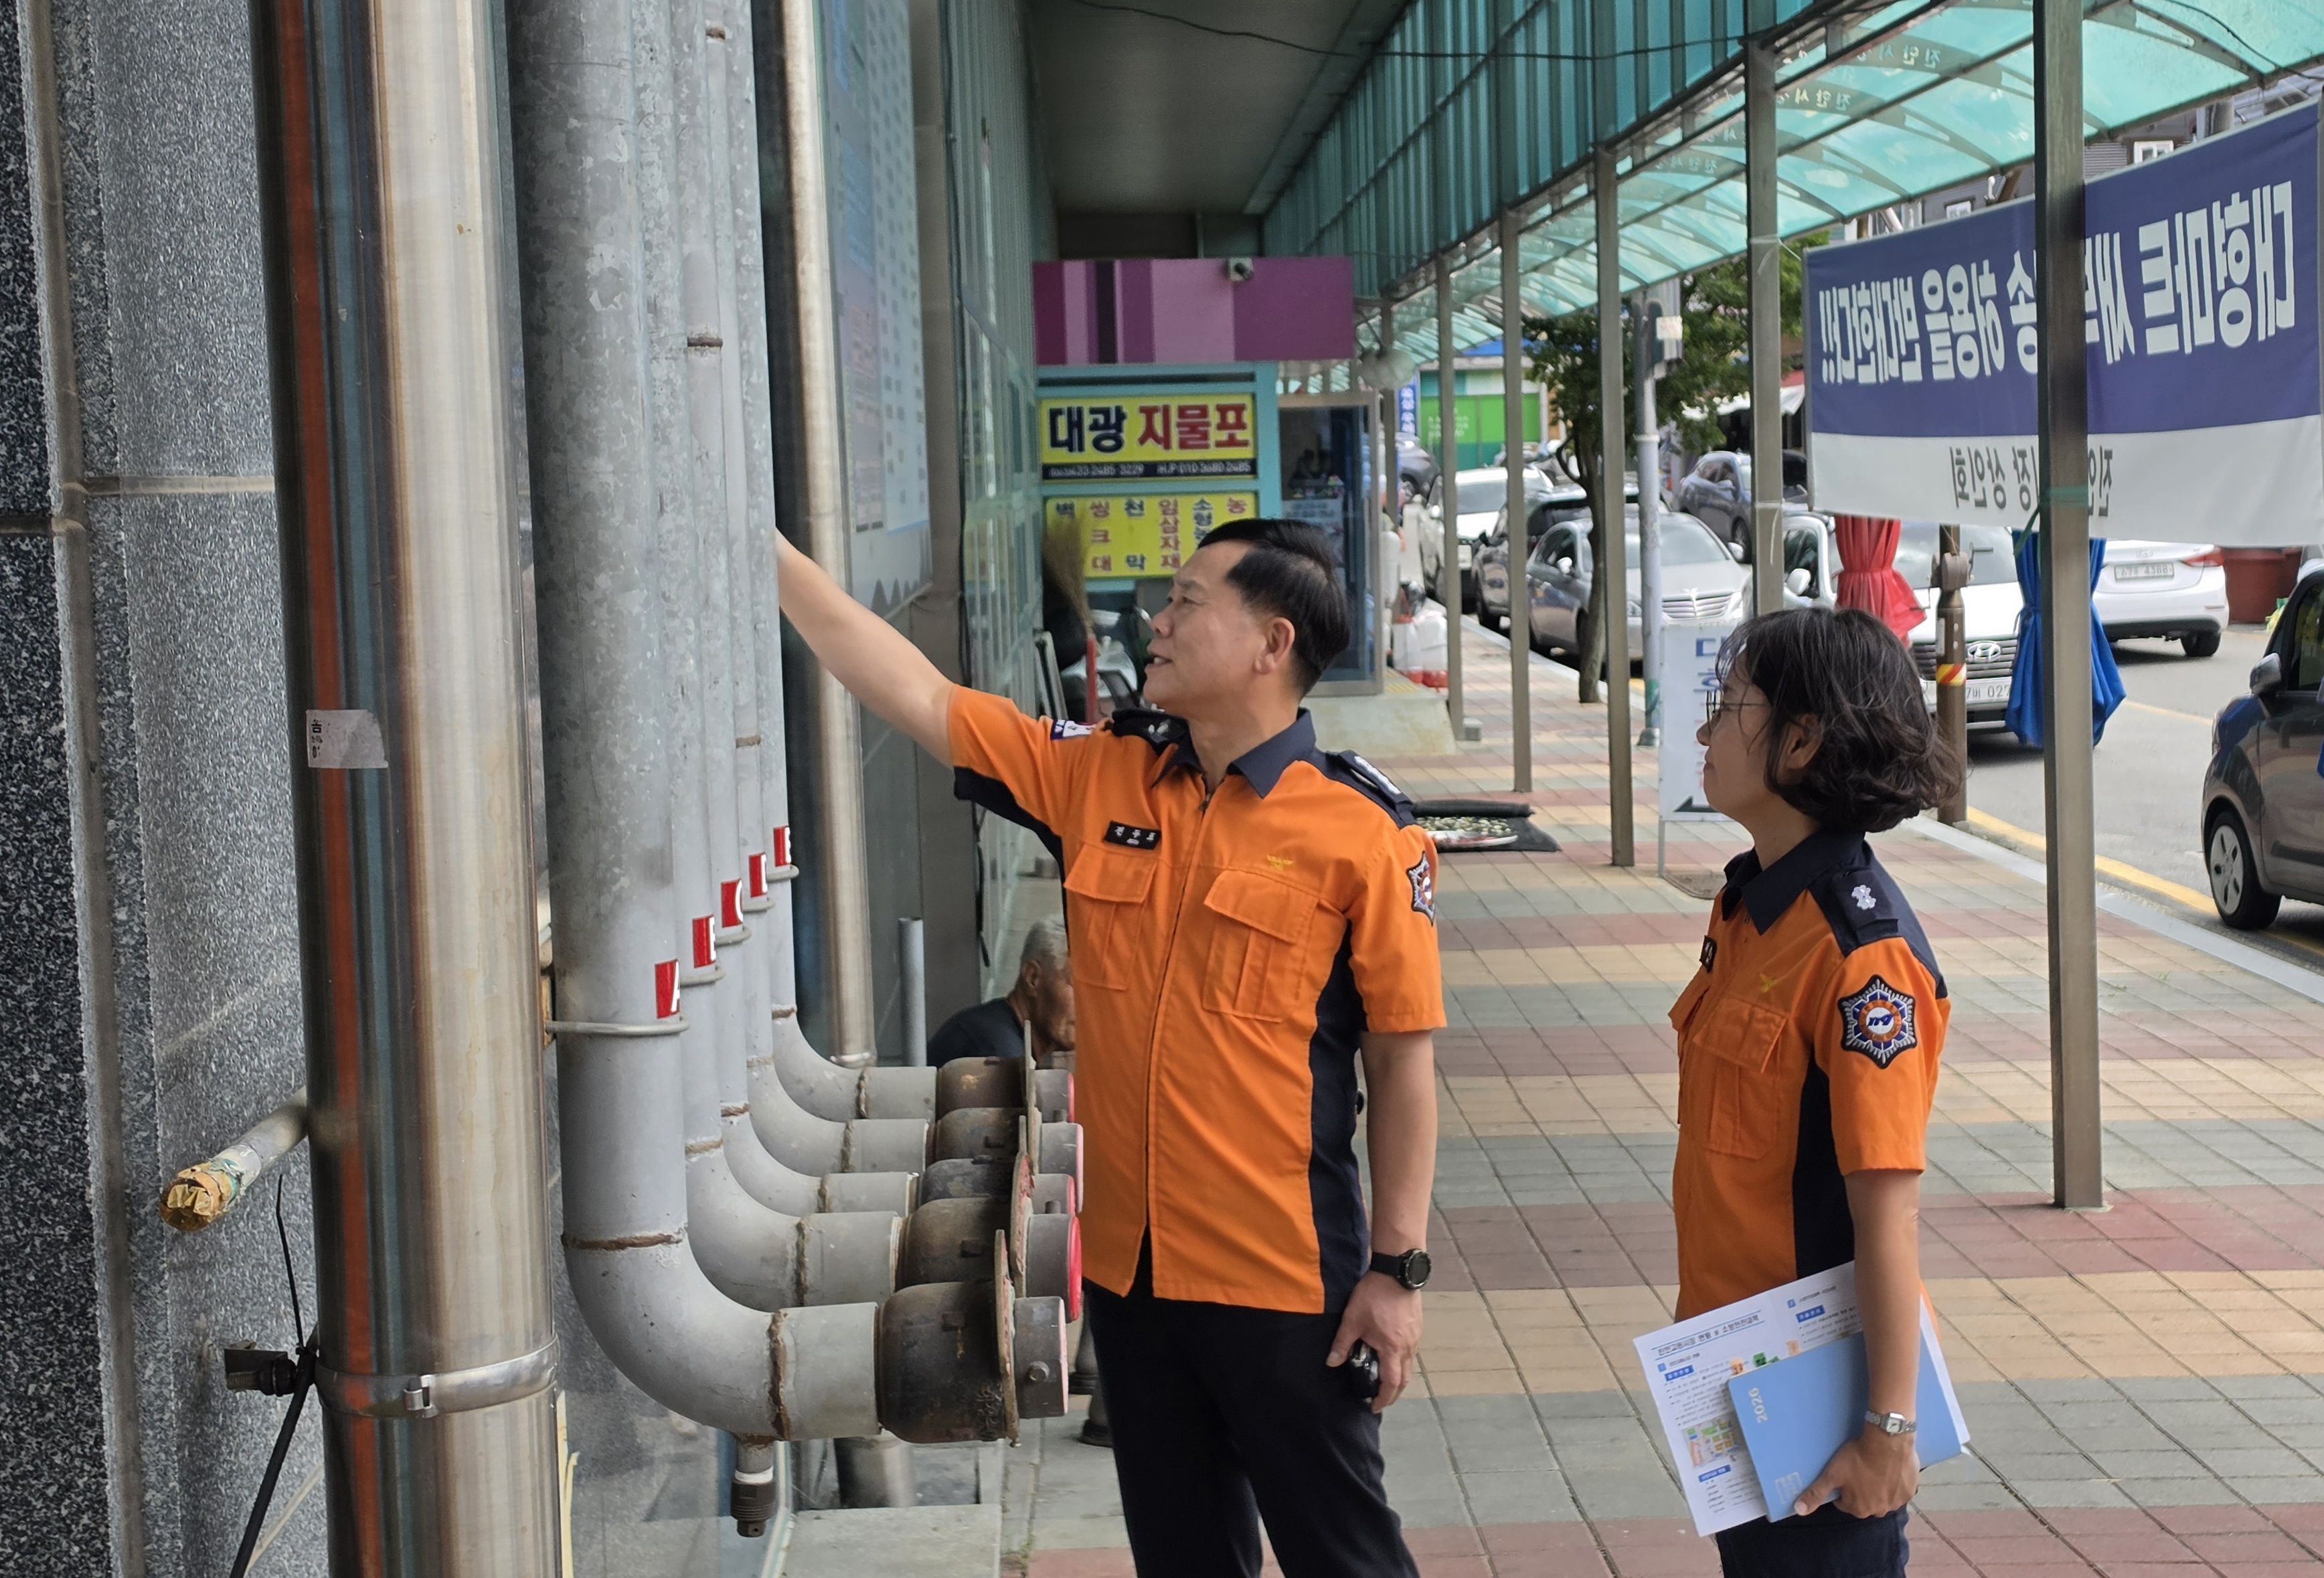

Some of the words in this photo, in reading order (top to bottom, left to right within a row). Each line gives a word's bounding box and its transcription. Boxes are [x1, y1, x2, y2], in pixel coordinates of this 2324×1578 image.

[1049, 404, 1127, 453] 대광
[1138, 404, 1250, 451] 지물포
[1125, 498, 1147, 570] 천막
[1748, 1387, 1768, 1424] 2026
